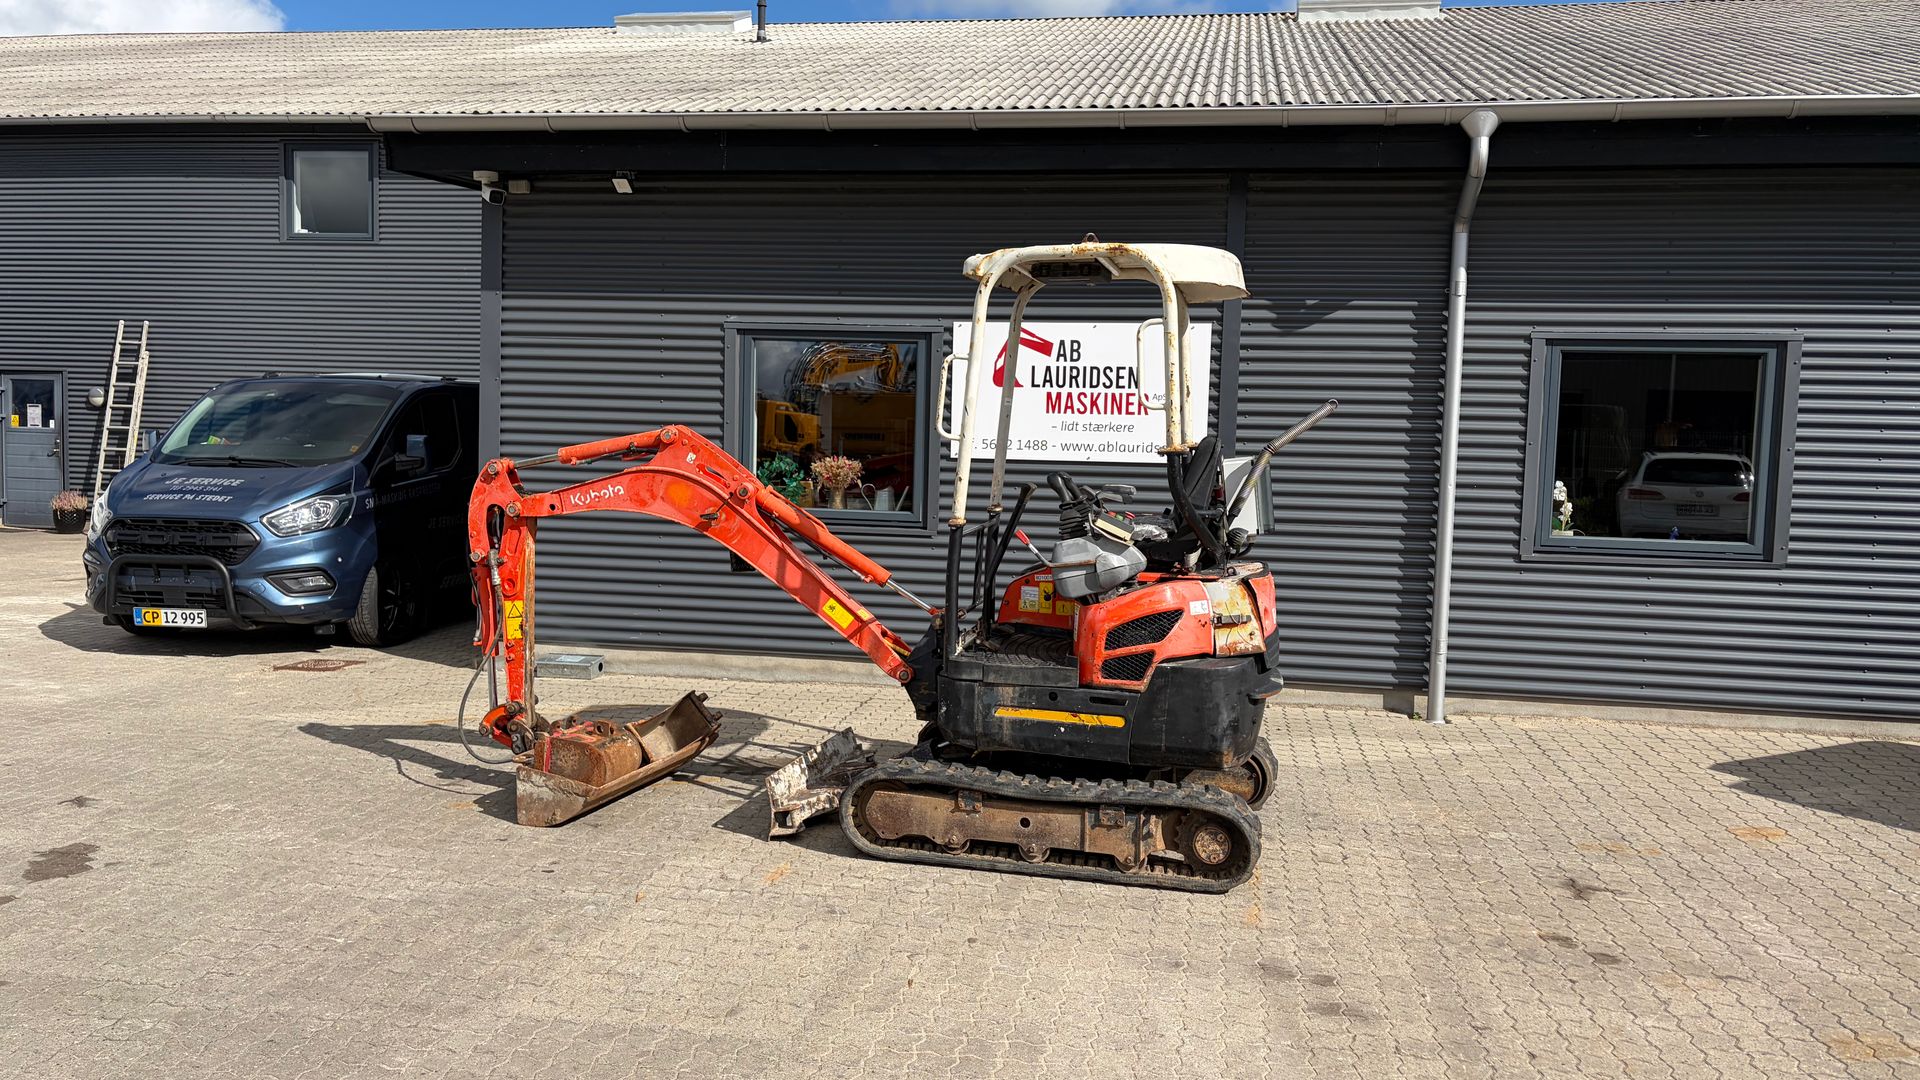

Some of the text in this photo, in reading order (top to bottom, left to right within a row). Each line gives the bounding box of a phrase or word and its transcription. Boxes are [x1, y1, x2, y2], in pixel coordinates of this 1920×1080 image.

[1056, 340, 1081, 362] AB
[1031, 366, 1139, 389] LAURIDSEN
[1061, 421, 1079, 432] lidt
[1082, 422, 1135, 433] stærkere
[982, 438, 1013, 450] 562
[1016, 440, 1048, 451] 1488
[184, 478, 245, 487] SERVICE
[195, 494, 233, 502] STEDET
[570, 484, 625, 506] Kubota
[143, 611, 204, 625] CP 12 995
